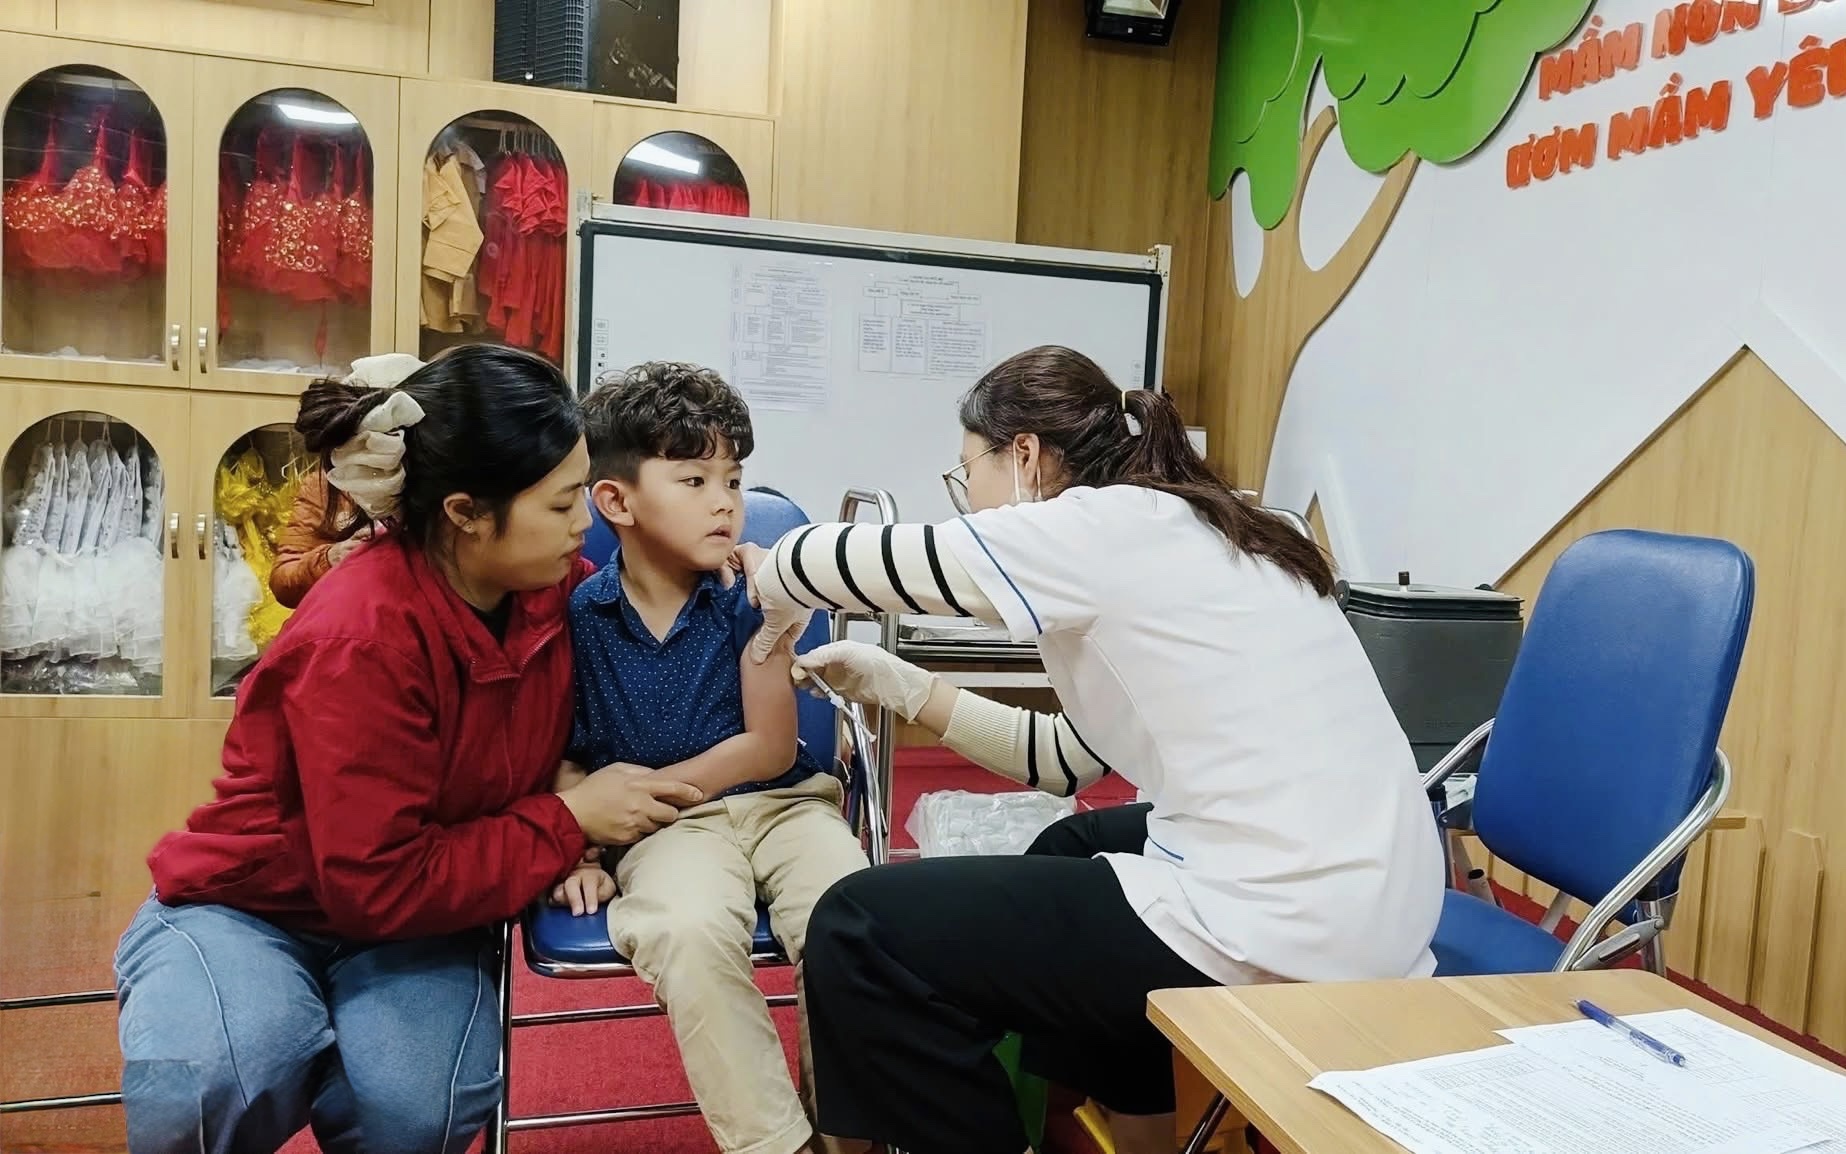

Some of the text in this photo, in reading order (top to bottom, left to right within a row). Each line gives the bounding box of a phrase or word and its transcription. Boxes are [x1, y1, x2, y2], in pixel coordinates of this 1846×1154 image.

[1538, 14, 1643, 101] MẦM
[1506, 122, 1598, 189] ƯƠM
[1607, 72, 1732, 160] MẦM
